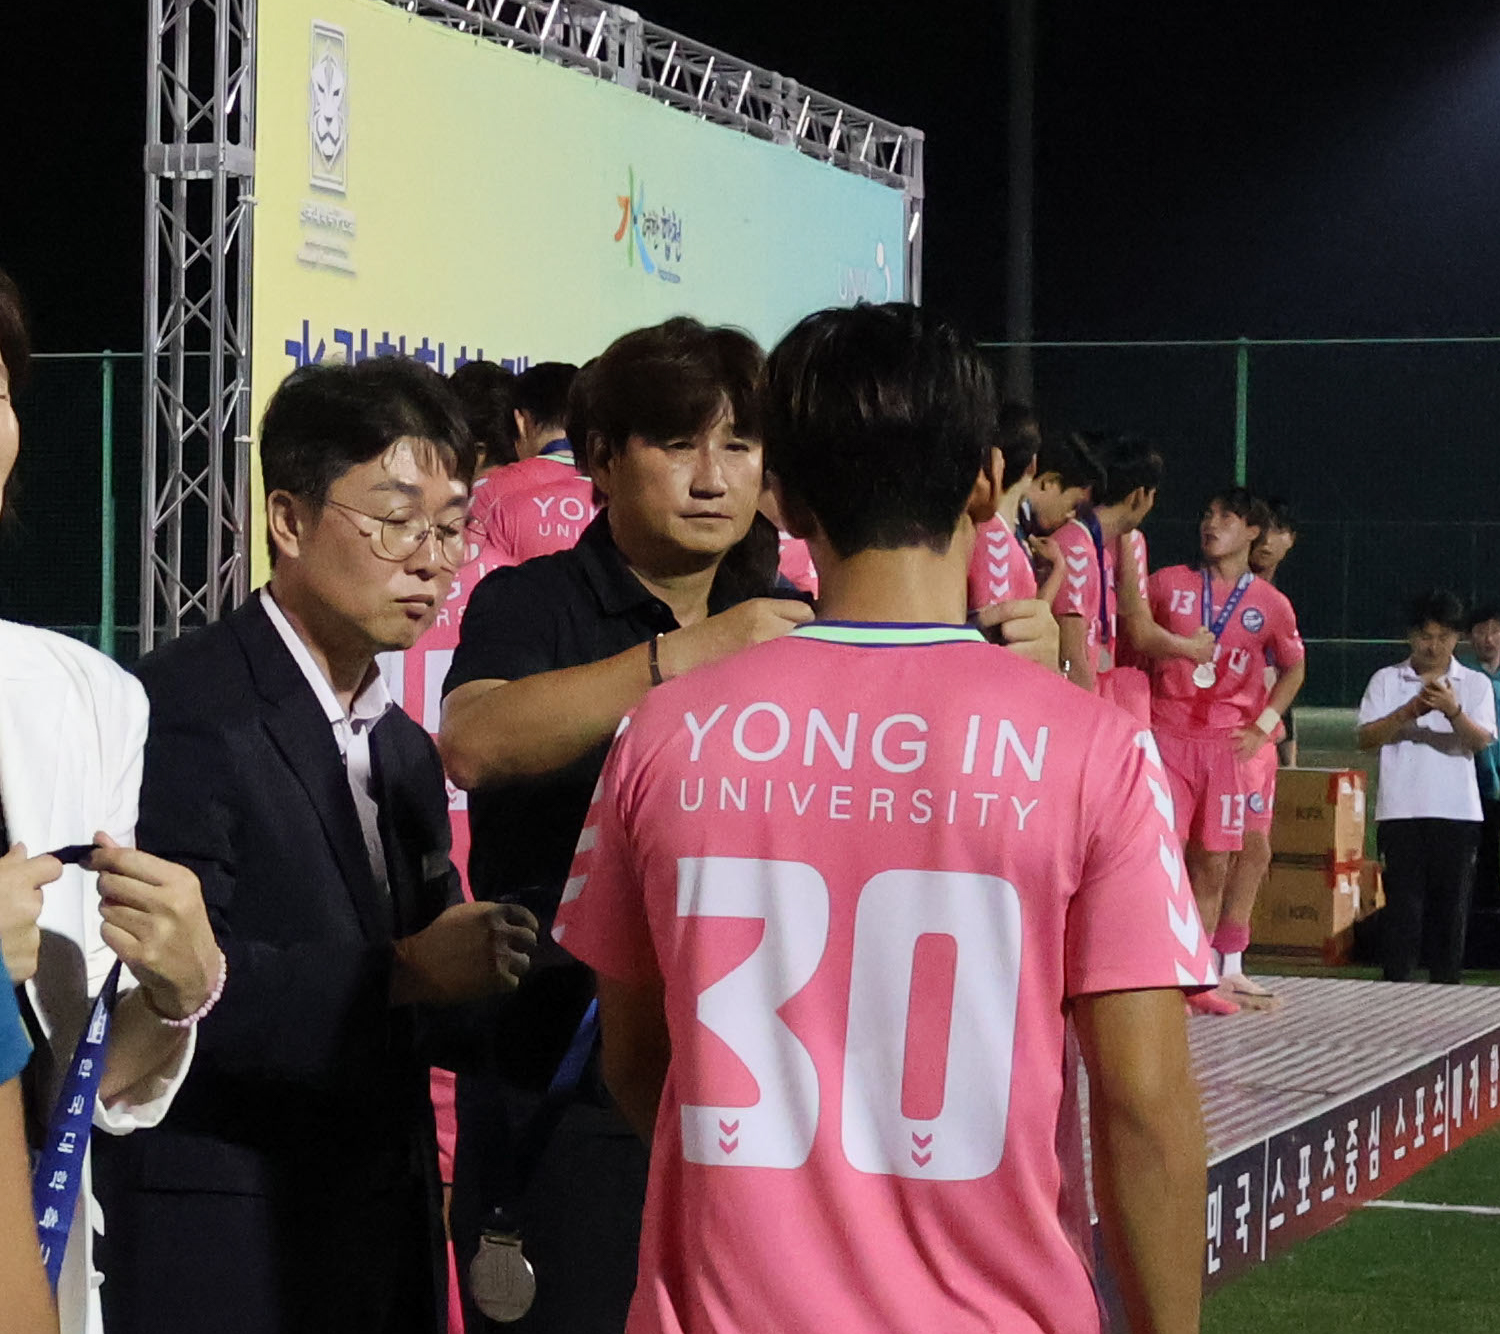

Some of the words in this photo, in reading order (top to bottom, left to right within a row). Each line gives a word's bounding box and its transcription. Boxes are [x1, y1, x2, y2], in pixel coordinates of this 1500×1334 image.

[1170, 589, 1196, 615] 13
[683, 701, 928, 773] YONG
[961, 714, 1049, 782] IN
[680, 777, 1040, 831] UNIVERSITY
[677, 857, 1023, 1181] 30
[1207, 1172, 1250, 1275] 민국
